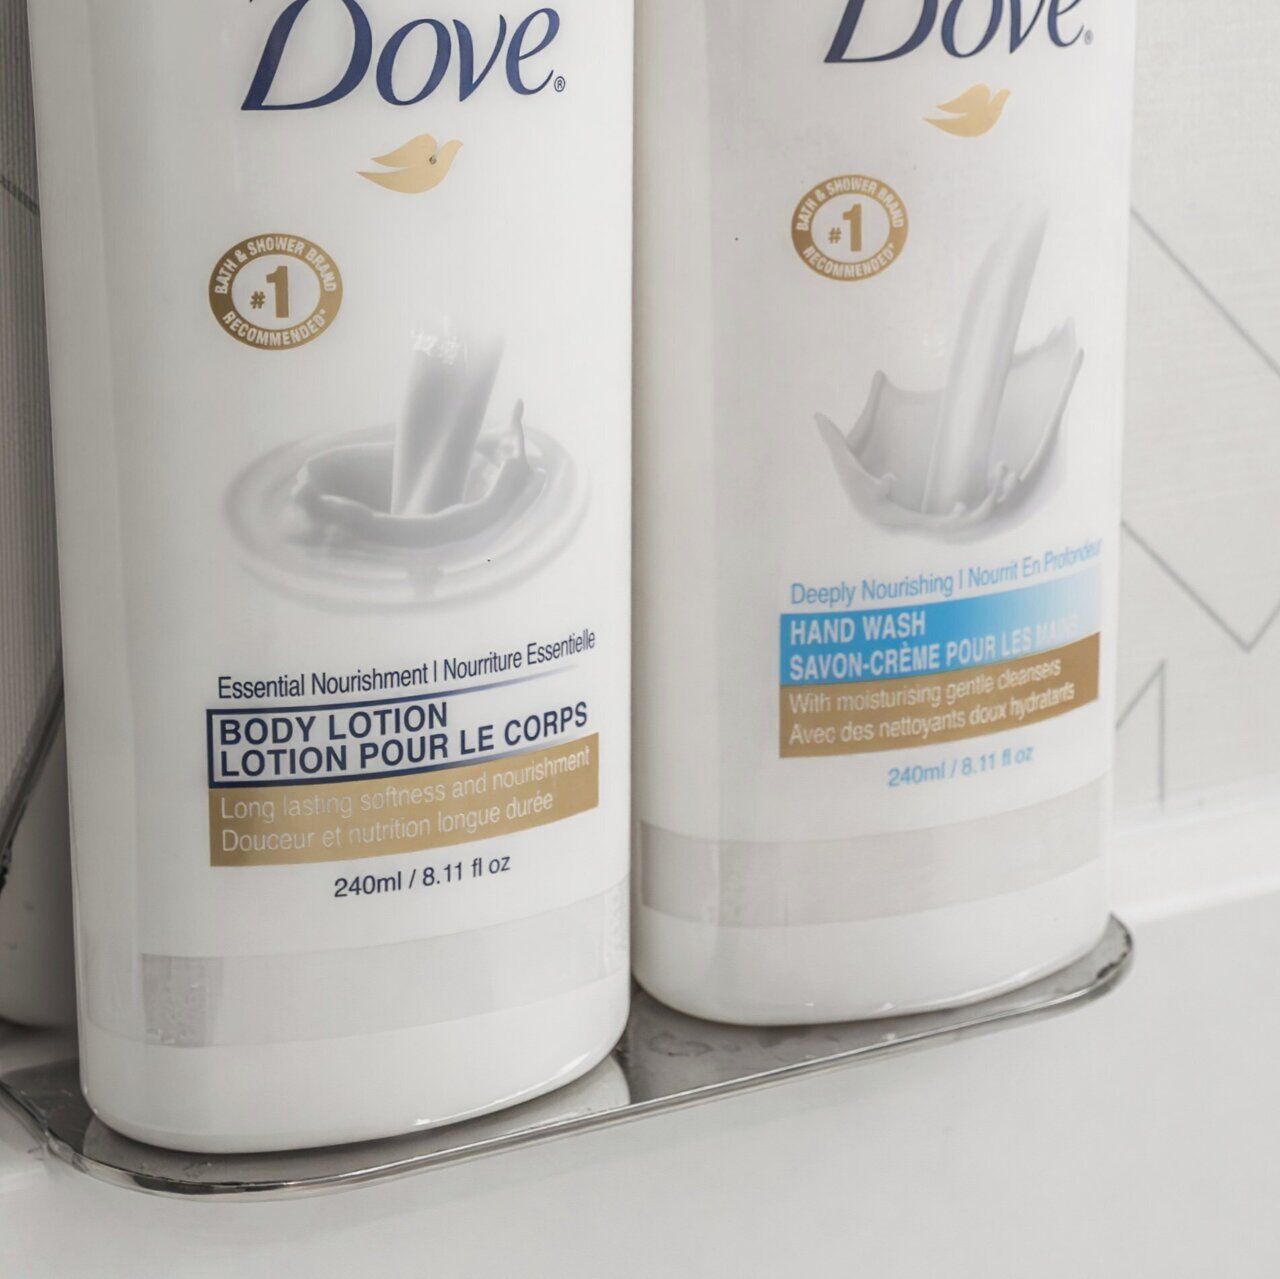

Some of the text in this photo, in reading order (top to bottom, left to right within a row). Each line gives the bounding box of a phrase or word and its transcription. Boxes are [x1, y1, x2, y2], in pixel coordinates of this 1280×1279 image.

[795, 198, 819, 231] BATH
[825, 177, 878, 195] SHOWER
[877, 186, 905, 228] BRAND
[828, 203, 863, 252] #1
[214, 236, 337, 295] BATH & SHOWER BRAND
[250, 266, 290, 319] #1
[791, 581, 856, 607] Deeply
[862, 571, 954, 601] Nourishing
[1023, 555, 1041, 578] En
[789, 641, 940, 681] SAVON-CRÈME
[945, 635, 996, 666] POUR
[1001, 625, 1032, 657] LES
[790, 610, 926, 645] HAND WASH
[218, 673, 305, 699] Essential
[312, 663, 428, 695] Nourishment
[444, 651, 522, 681] Nourriture
[527, 628, 596, 666] Essentielle
[788, 658, 1062, 714] With moisturising gentle cleansers
[220, 702, 448, 745] BODY LOTION
[221, 701, 588, 777] LOTION POUR LE CORPS
[788, 681, 1075, 745] Avec des nettoyants doux hydratants
[221, 745, 590, 823] Long lasting softness and nourishment
[888, 761, 946, 788] 240ml
[961, 752, 996, 776] 8.11
[1015, 746, 1035, 764] oz
[222, 790, 554, 852] Douceur et nutrition longue durée
[334, 871, 402, 897] 240ml
[422, 862, 463, 886] 8.11
[472, 857, 483, 878] fl
[489, 856, 511, 874] oz
